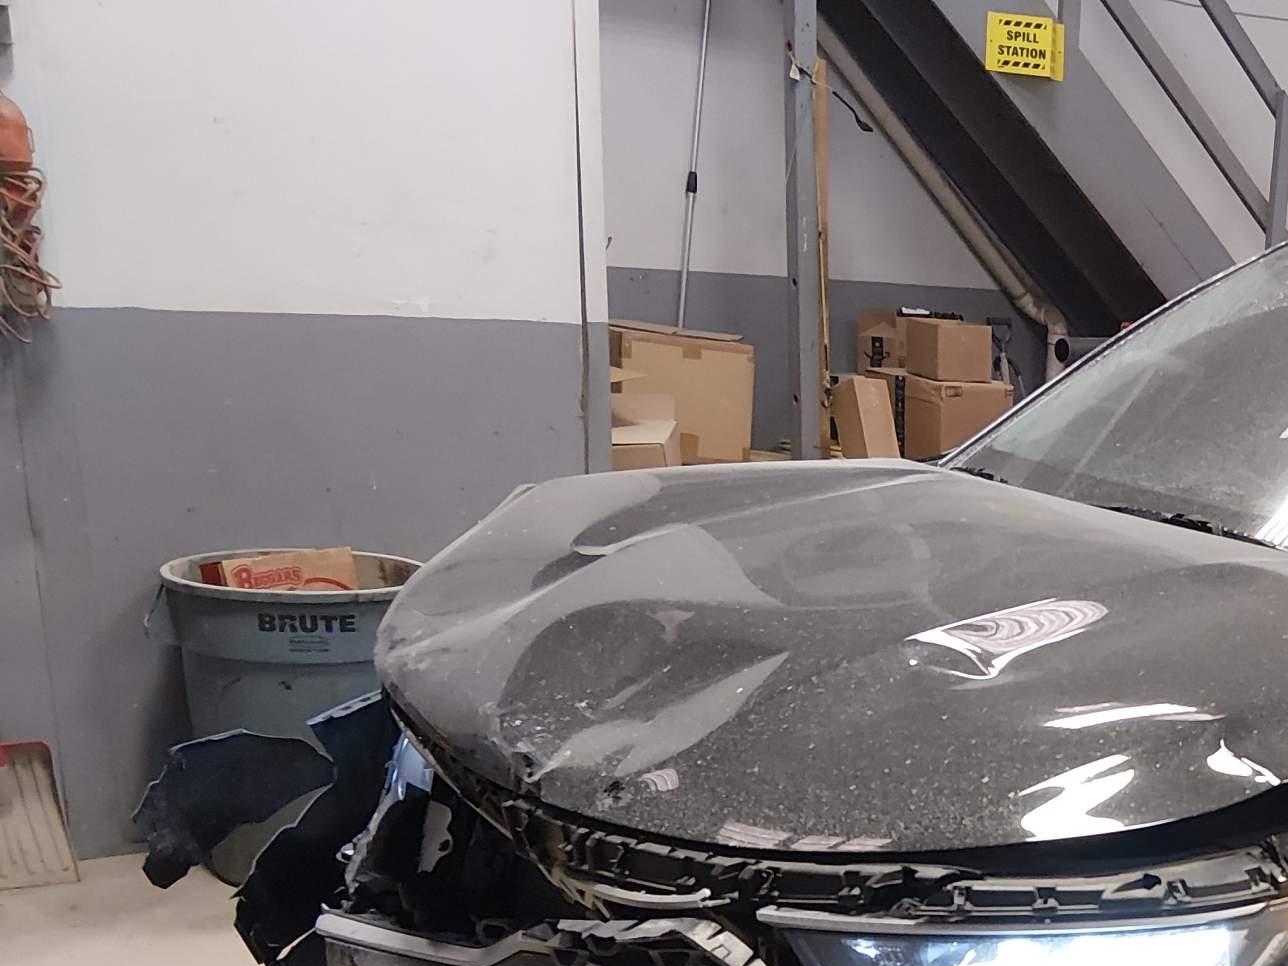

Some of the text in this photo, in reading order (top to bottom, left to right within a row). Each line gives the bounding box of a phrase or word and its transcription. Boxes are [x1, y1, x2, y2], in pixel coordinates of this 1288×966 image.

[1006, 30, 1039, 43] SPILL
[997, 45, 1046, 60] STATION
[257, 613, 357, 633] BRUTE
